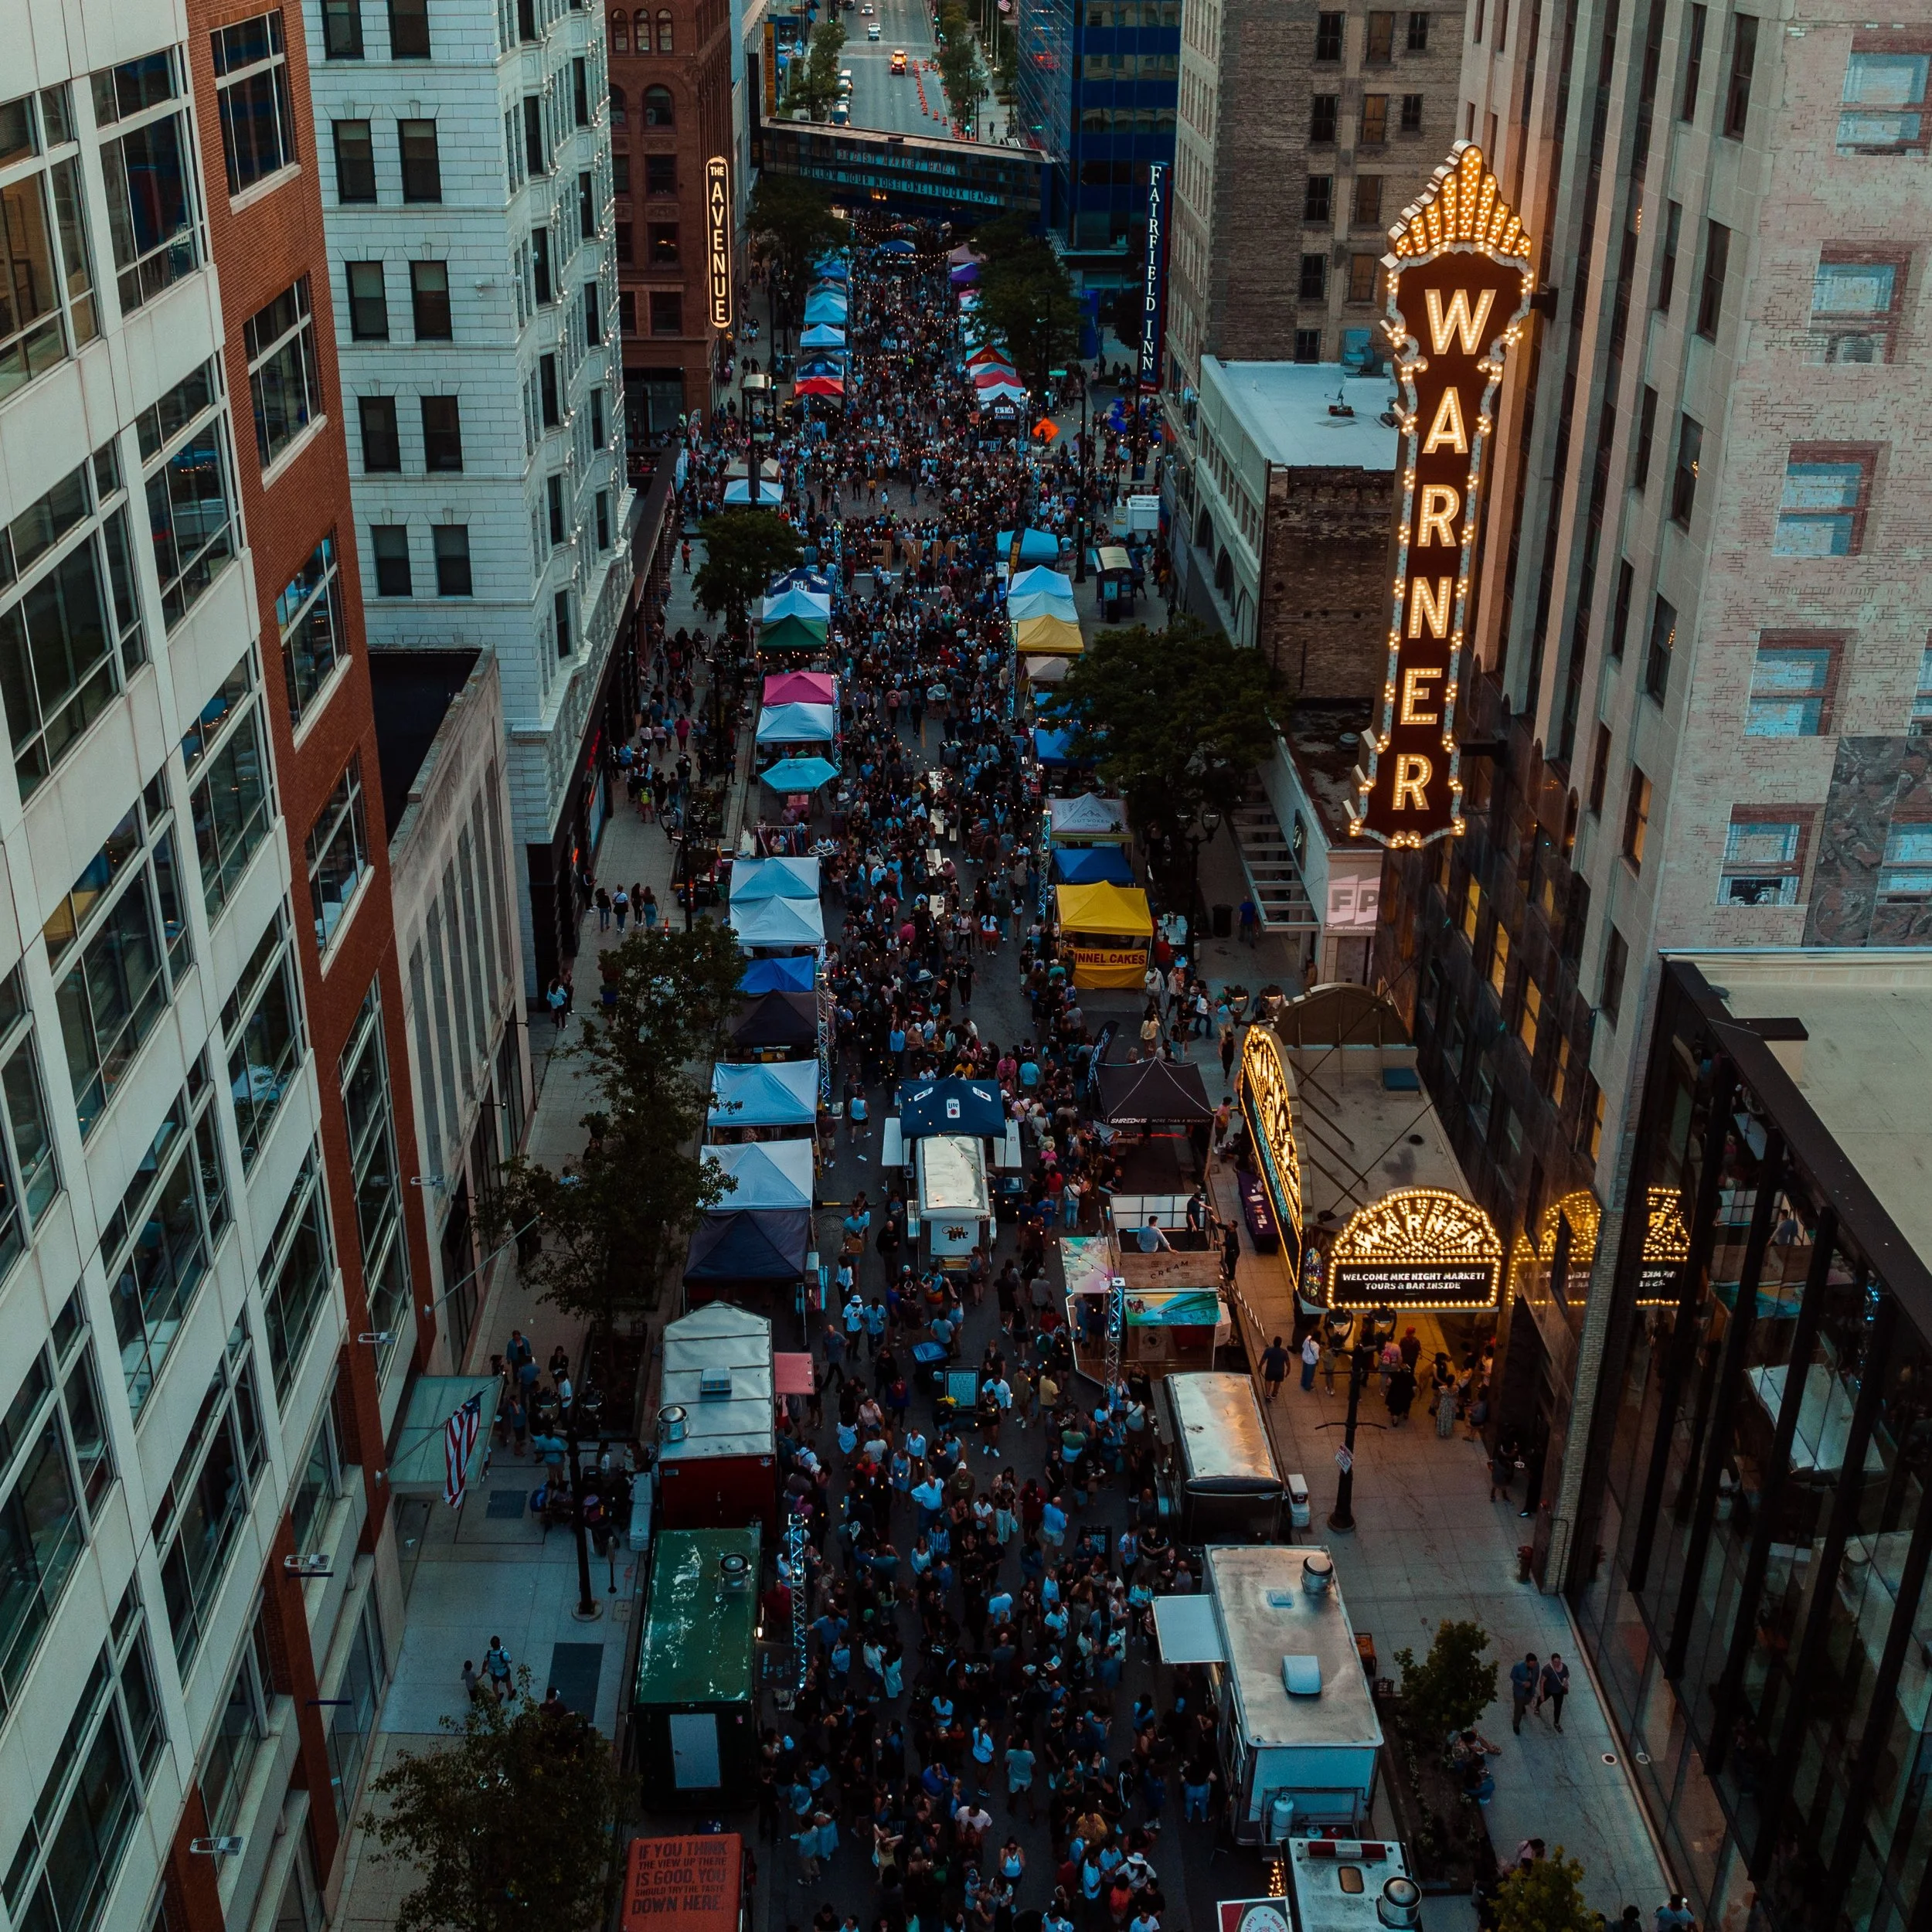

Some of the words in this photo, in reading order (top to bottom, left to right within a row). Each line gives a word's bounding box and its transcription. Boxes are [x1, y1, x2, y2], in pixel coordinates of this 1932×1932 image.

[710, 166, 724, 176] THE
[801, 167, 837, 180] FOLLOW
[845, 172, 869, 185] YOUR
[875, 177, 900, 189] NOSE
[906, 181, 926, 193] ONE
[971, 190, 998, 203] EAST
[1145, 165, 1162, 312] FAIRFIELD
[711, 182, 726, 321] AVENUE
[1142, 320, 1154, 370] INN
[1393, 288, 1497, 811] WARNER
[1332, 889, 1379, 912] FP
[1075, 953, 1106, 963] NNEL
[1109, 954, 1145, 964] CAKES
[1355, 1213, 1481, 1250] WARNER
[1150, 1260, 1189, 1279] CREAM
[639, 1845, 650, 1859] IF
[655, 1842, 682, 1857] YOU
[687, 1841, 727, 1855] THINK
[639, 1860, 655, 1870] THE
[658, 1858, 681, 1867] VIEW
[684, 1857, 696, 1866] UP
[699, 1856, 726, 1866] THERE
[636, 1872, 649, 1887] IS
[699, 1868, 726, 1883] YOU
[635, 1887, 665, 1896] SHOULD
[702, 1885, 724, 1893] TASTE
[631, 1897, 677, 1915] DOWN
